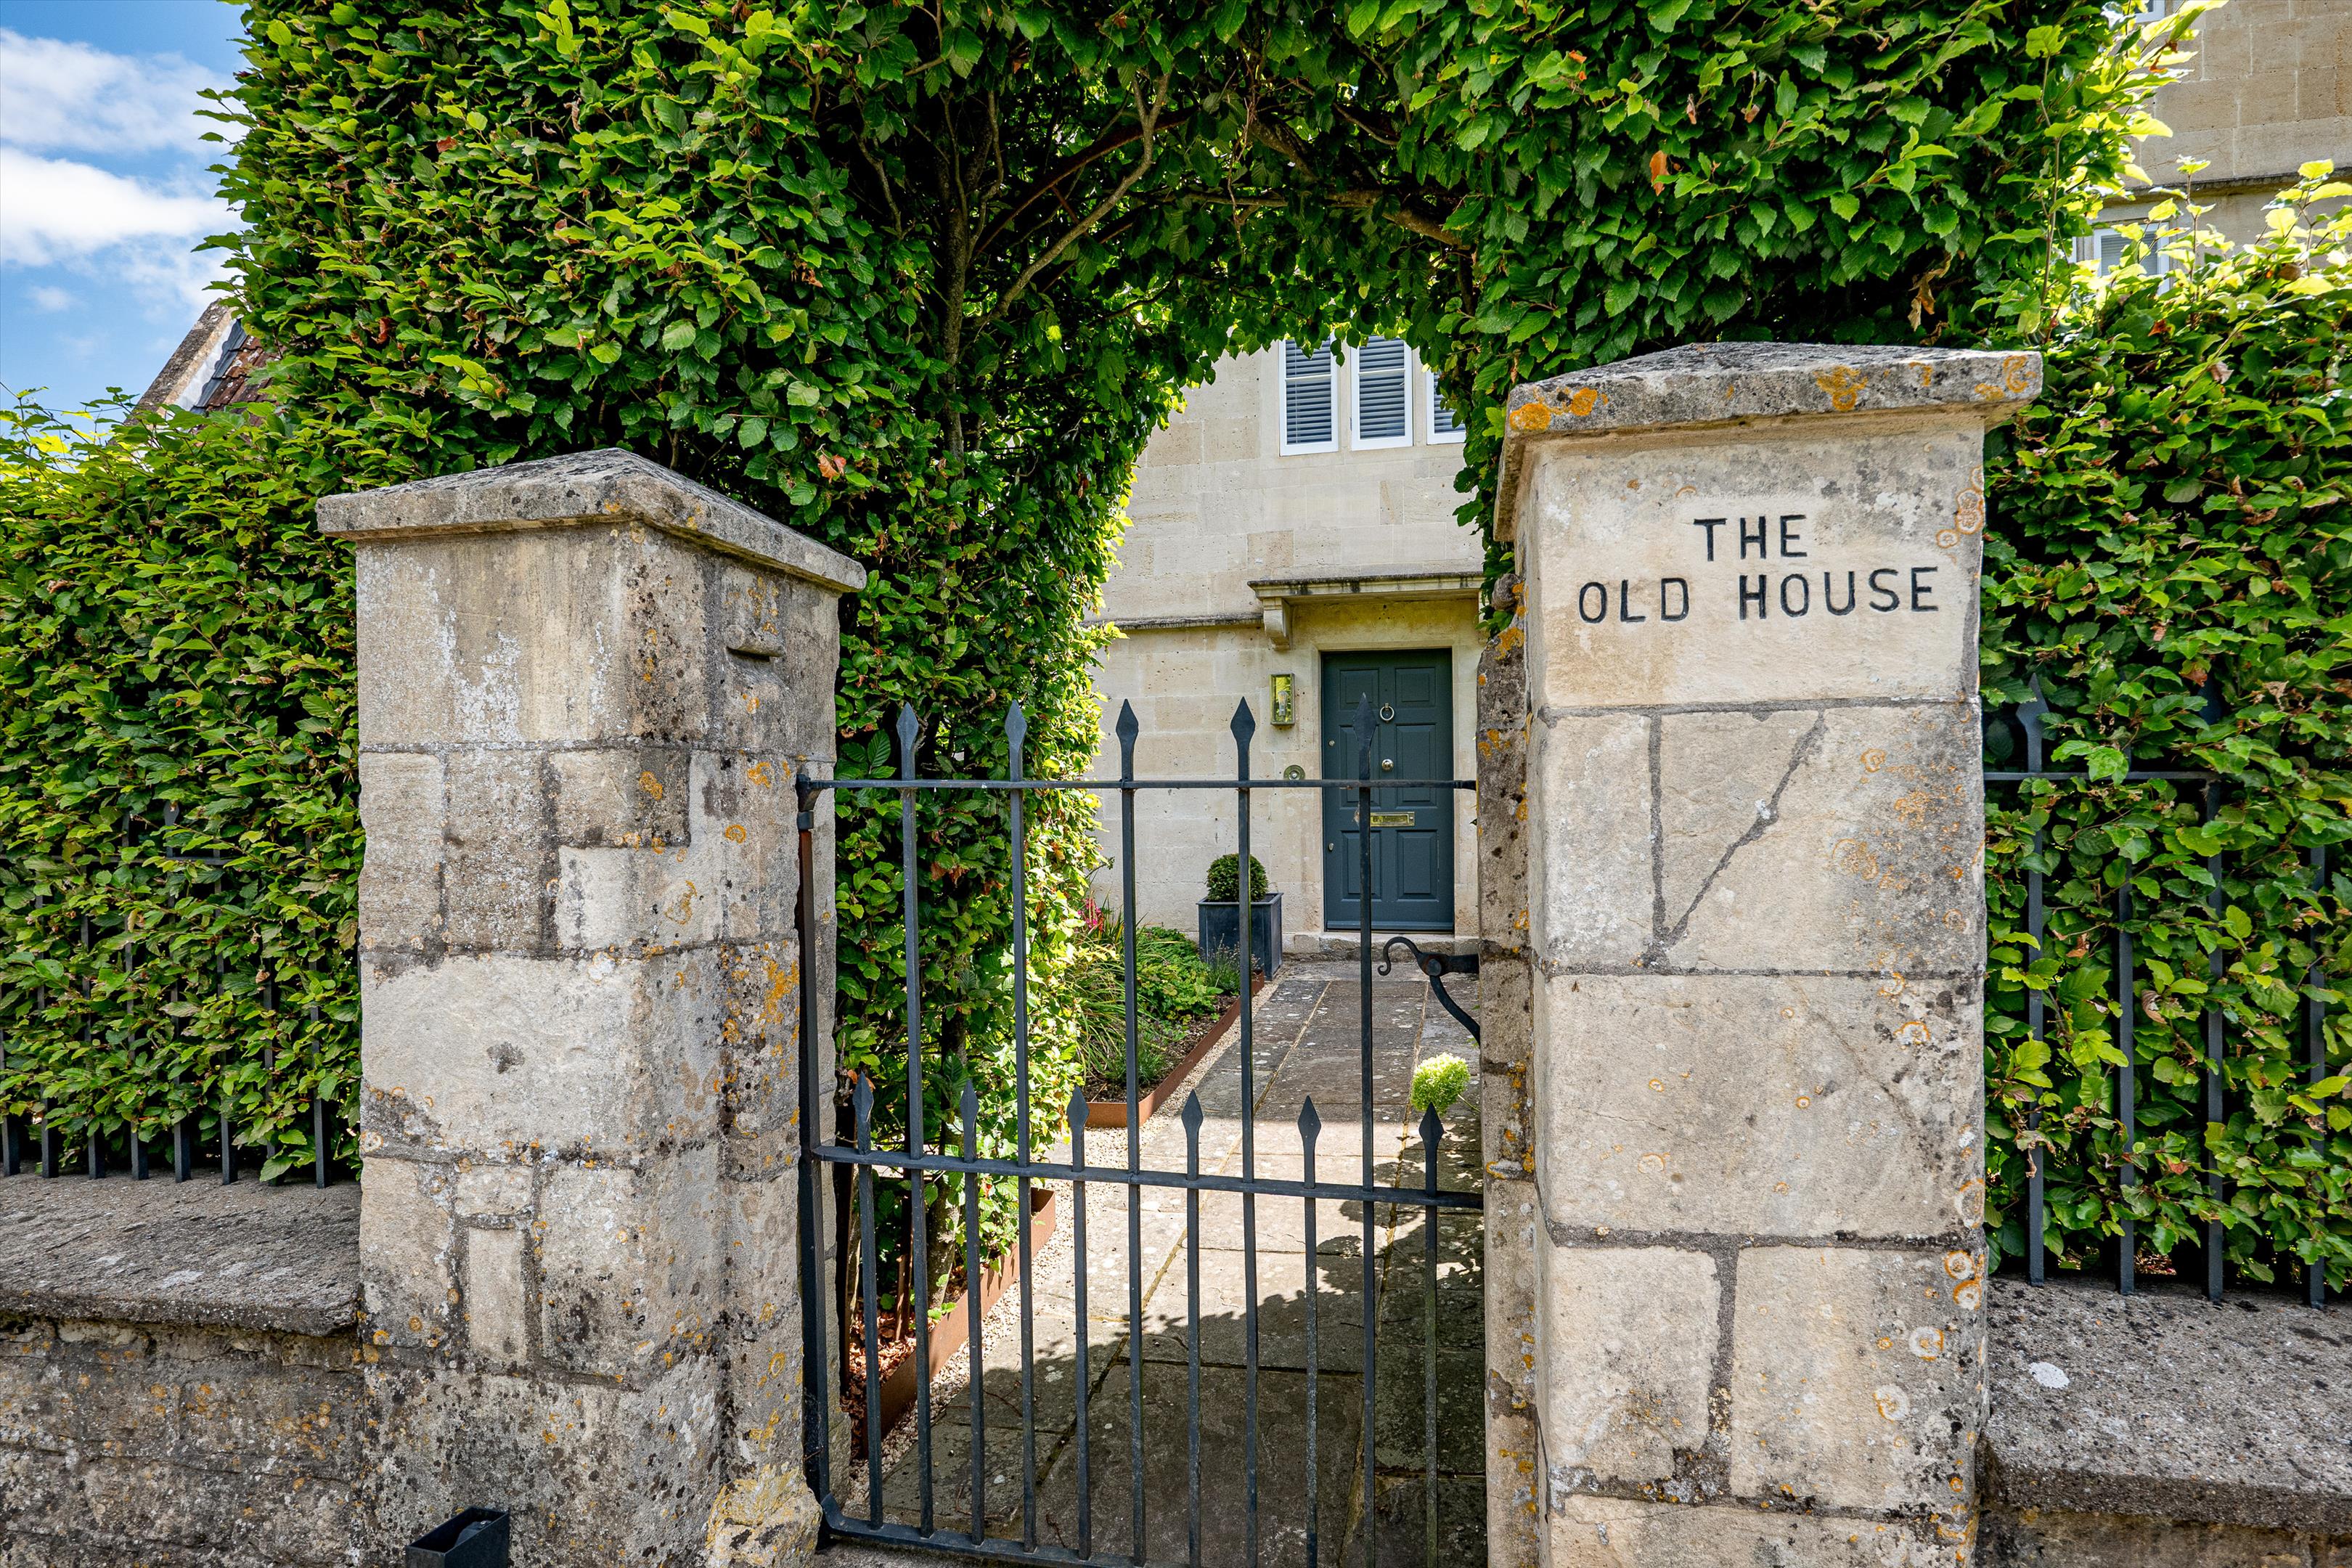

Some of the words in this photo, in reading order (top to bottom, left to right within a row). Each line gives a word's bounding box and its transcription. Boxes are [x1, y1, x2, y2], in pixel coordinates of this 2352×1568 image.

[1693, 514, 1808, 562] THE
[1578, 576, 1689, 623] OLD
[1739, 566, 1939, 621] HOUSE
